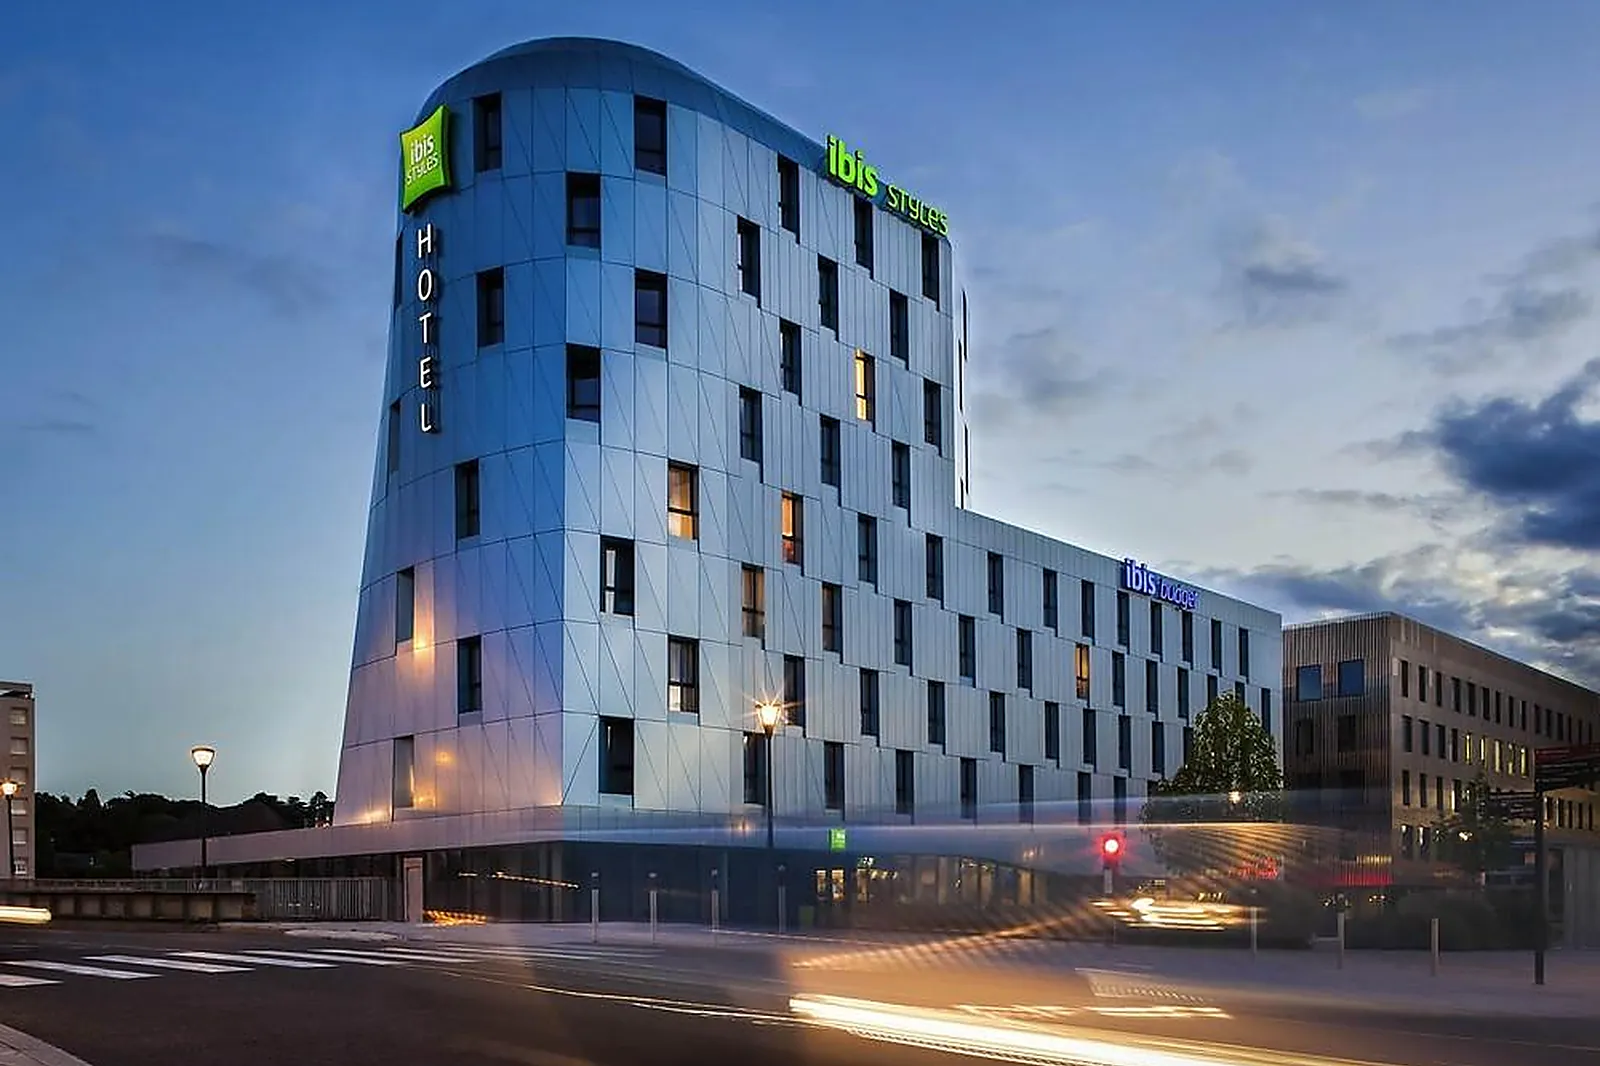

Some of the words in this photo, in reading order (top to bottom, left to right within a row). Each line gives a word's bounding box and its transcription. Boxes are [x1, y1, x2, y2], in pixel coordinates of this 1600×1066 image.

[411, 133, 434, 165] ibis
[828, 134, 878, 196] ibis
[417, 223, 432, 432] HOTEL
[1125, 558, 1156, 595] ibis
